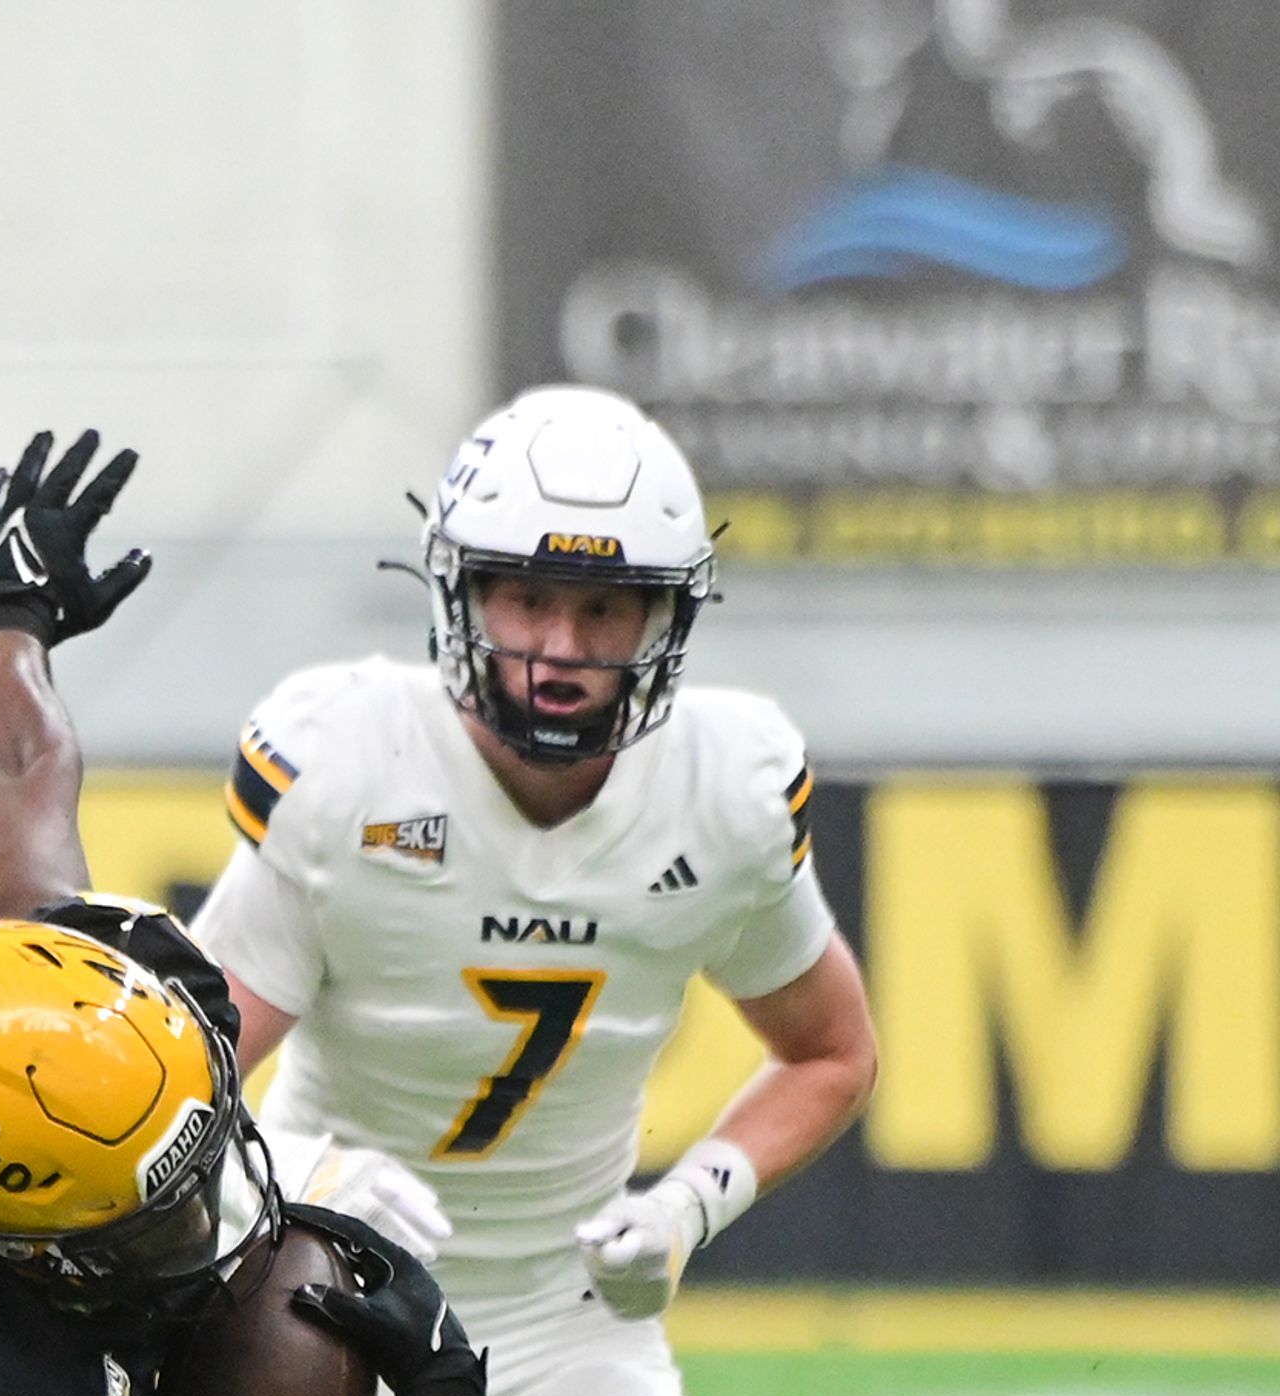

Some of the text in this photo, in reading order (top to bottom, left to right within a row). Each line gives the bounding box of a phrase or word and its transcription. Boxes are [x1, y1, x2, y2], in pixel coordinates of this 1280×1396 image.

[548, 532, 618, 557] NAU
[397, 818, 444, 850] SKY
[480, 915, 599, 945] NAU
[430, 967, 608, 1162] 7
[148, 1110, 204, 1187] IDAHO
